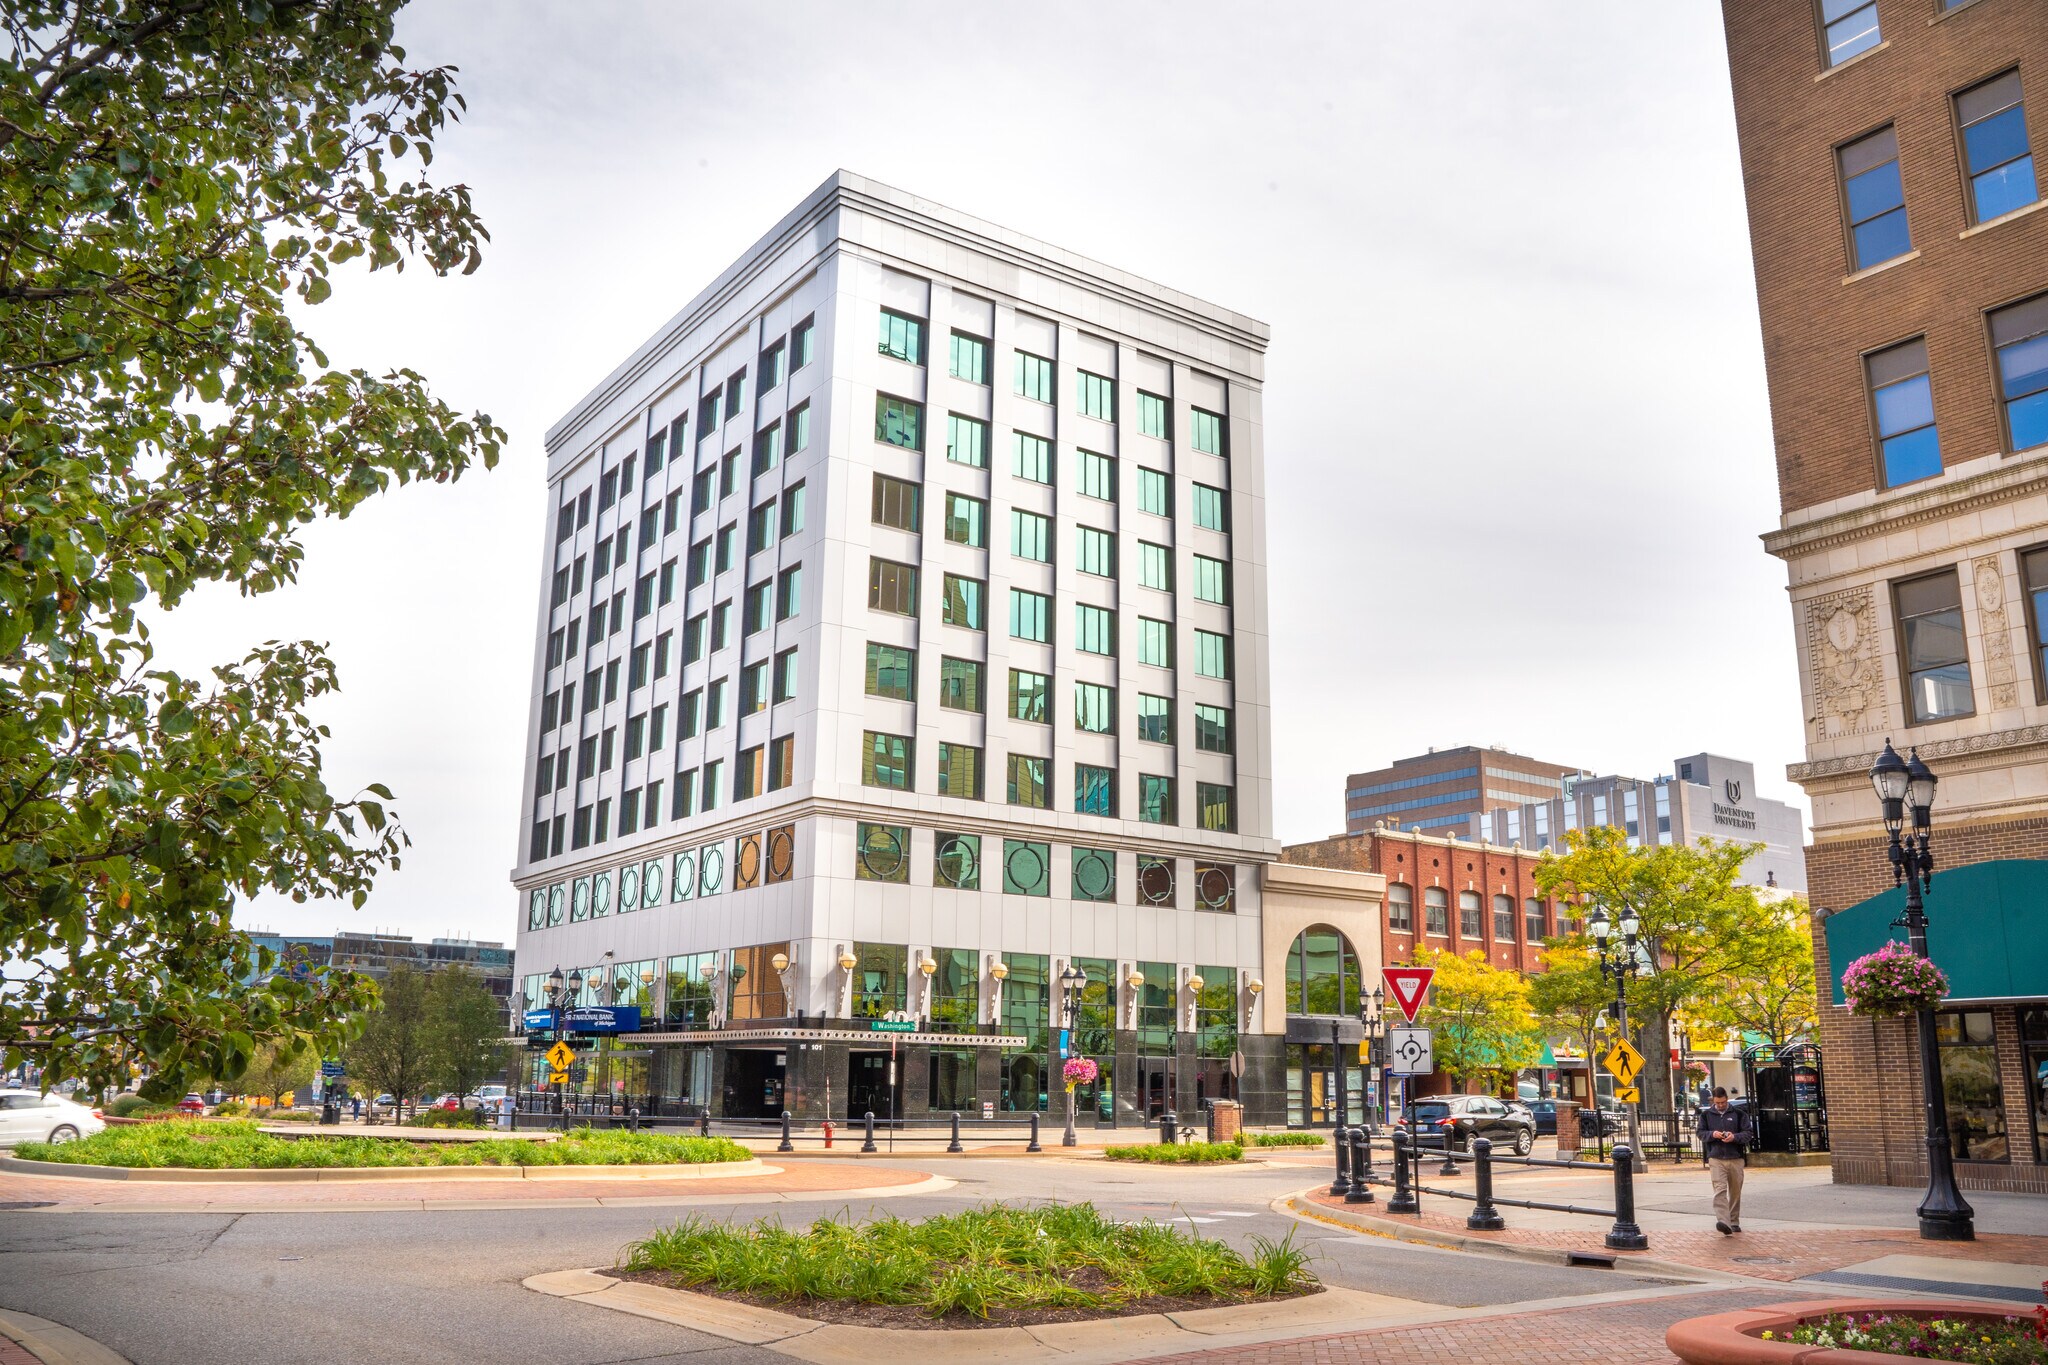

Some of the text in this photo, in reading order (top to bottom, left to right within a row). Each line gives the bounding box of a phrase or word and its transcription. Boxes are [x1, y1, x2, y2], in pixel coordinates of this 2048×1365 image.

[1713, 802, 1755, 820] DAVENPORT
[1714, 814, 1756, 830] UNIVERSITY
[1401, 981, 1417, 989] YIELD
[565, 1013, 615, 1021] FIRT NATIONAL BANK
[706, 1010, 726, 1030] 101
[877, 1021, 911, 1031] Washington
